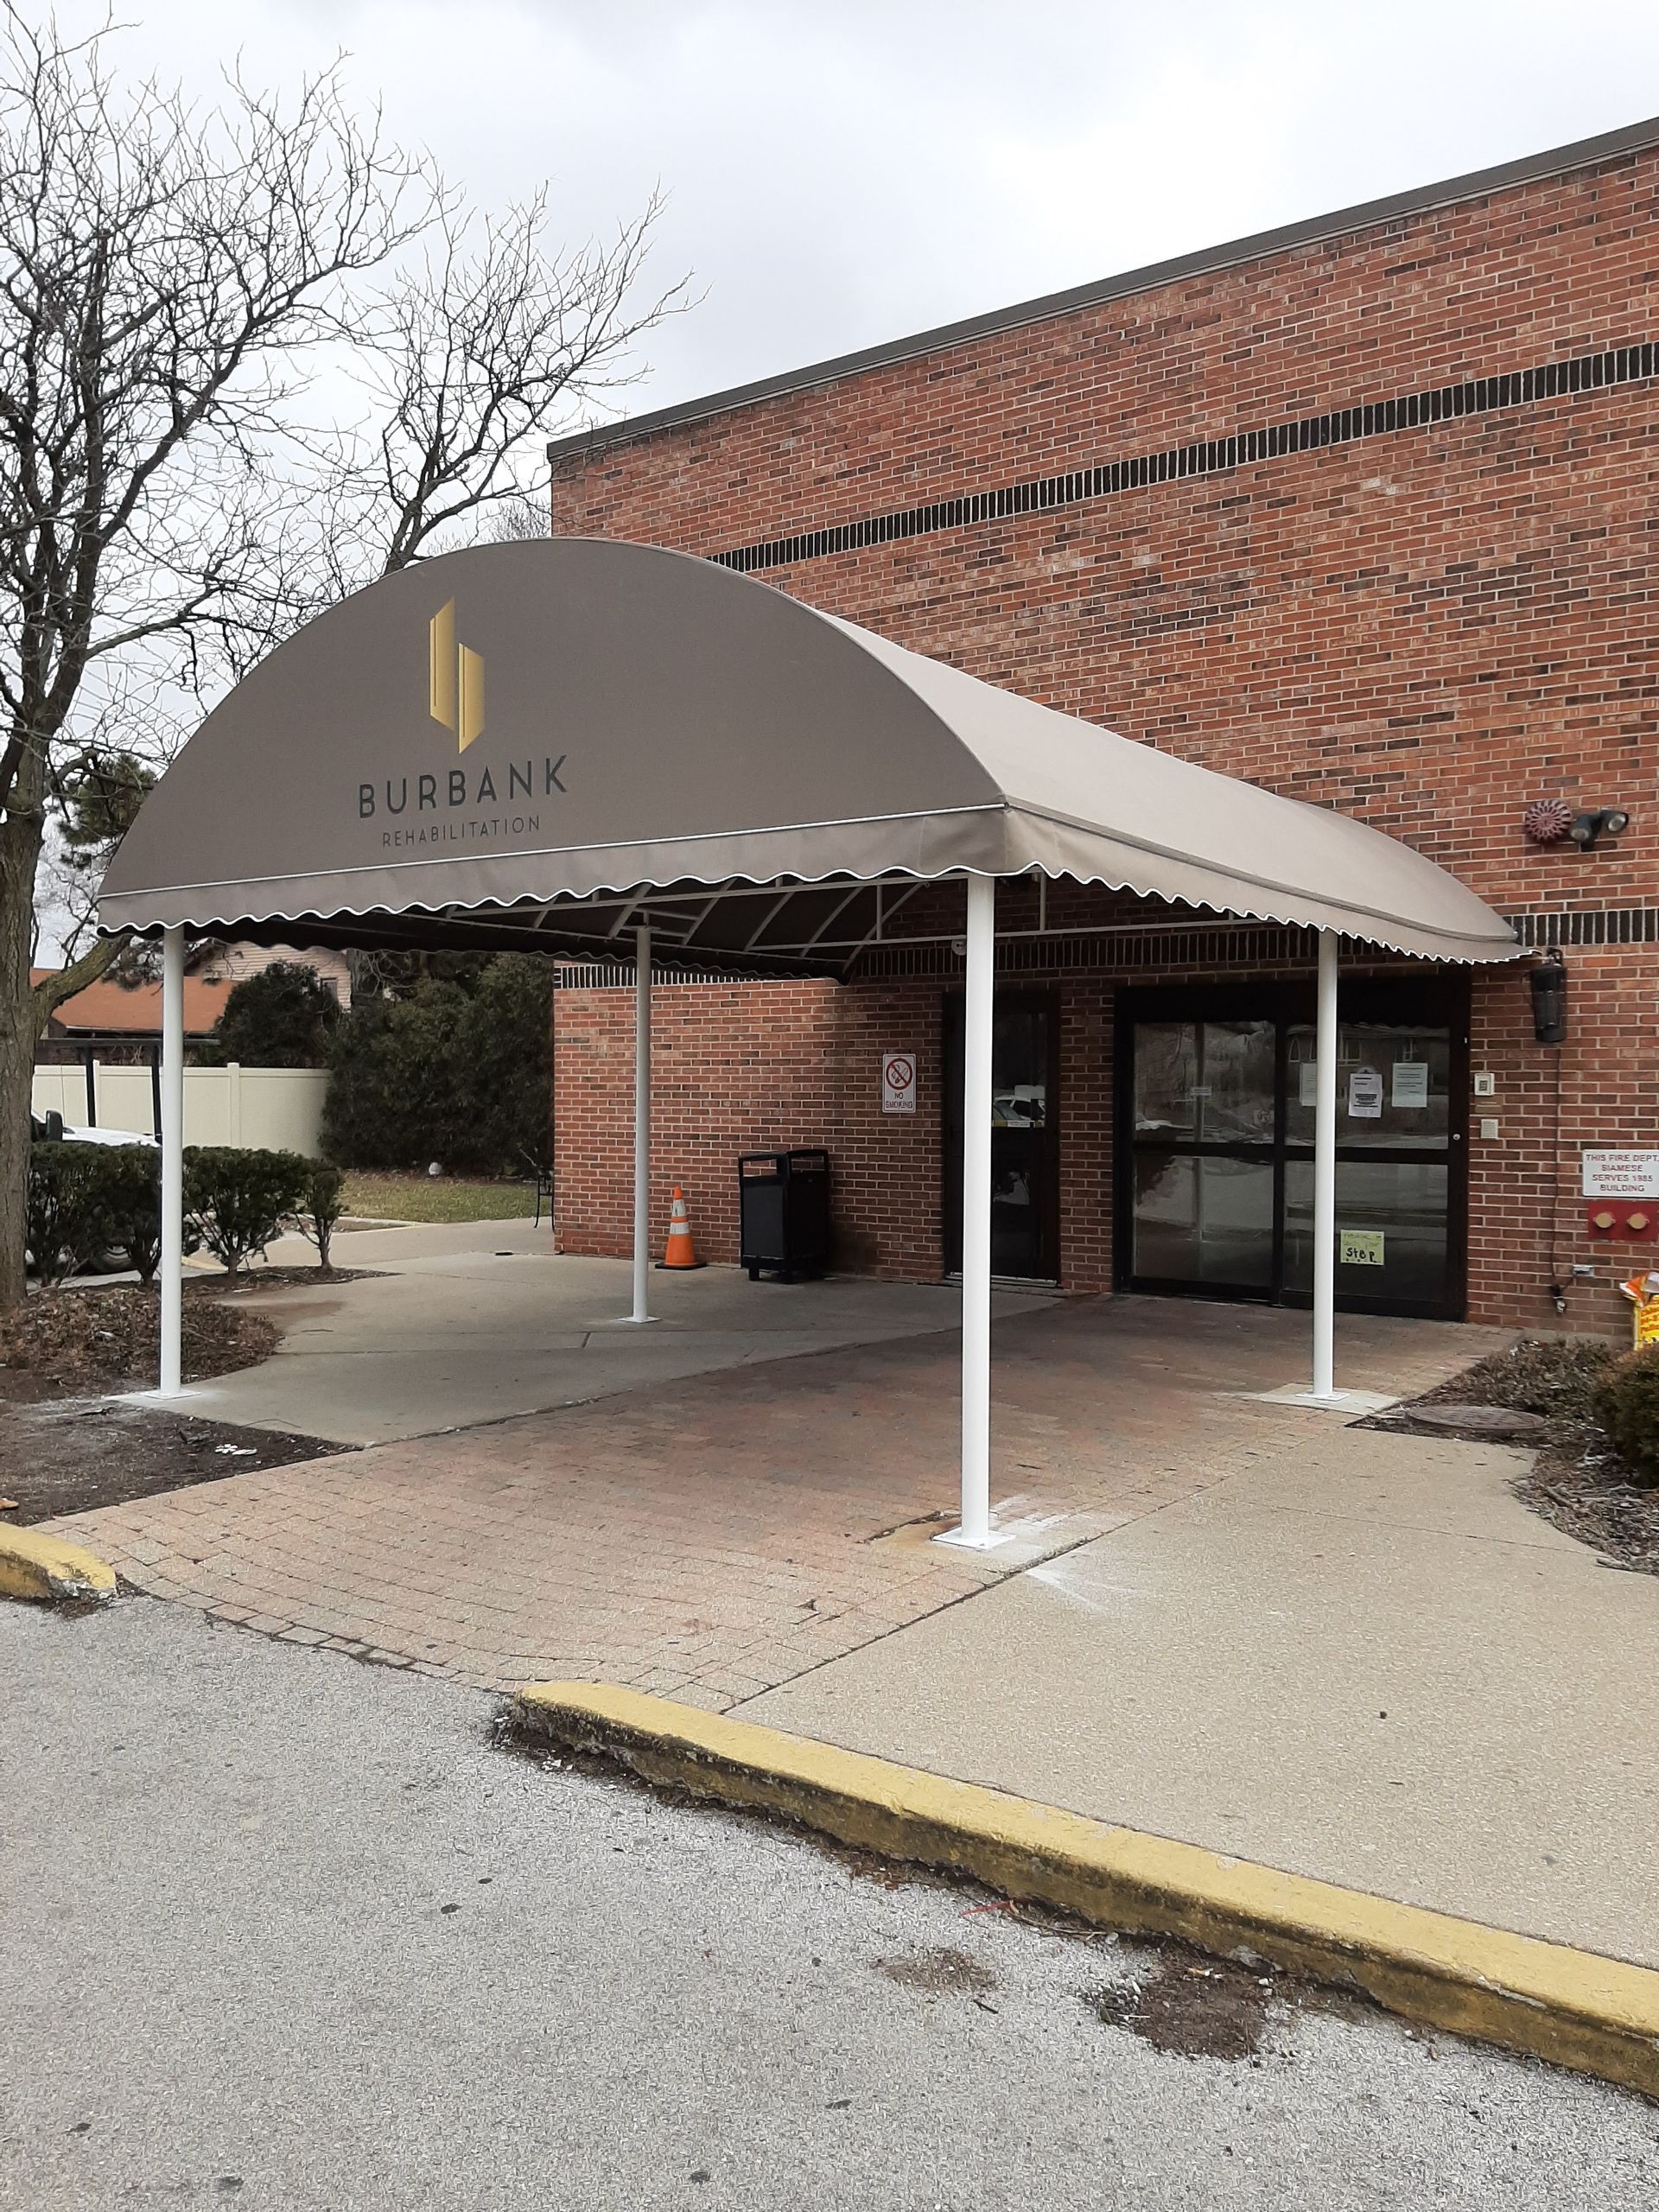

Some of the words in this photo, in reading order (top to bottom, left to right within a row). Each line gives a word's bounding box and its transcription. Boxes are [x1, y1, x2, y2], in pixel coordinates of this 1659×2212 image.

[359, 754, 568, 819] BURBANK
[382, 815, 540, 849] REHABILITATION
[1592, 1173, 1630, 1182] SERVES
[1599, 1184, 1645, 1192] BUILDING
